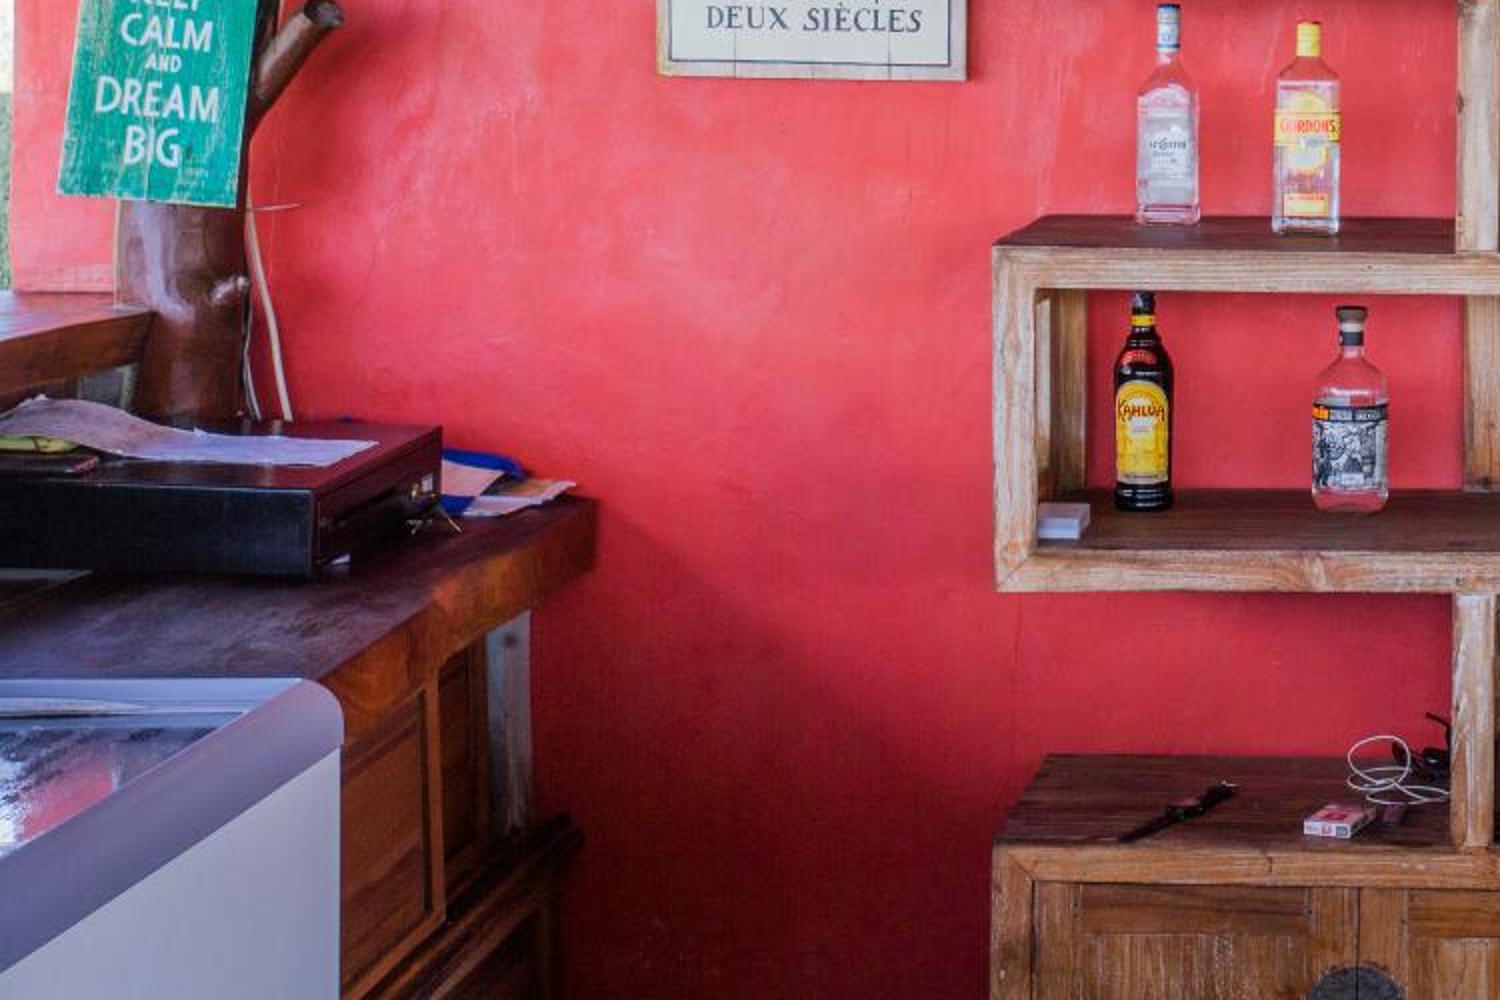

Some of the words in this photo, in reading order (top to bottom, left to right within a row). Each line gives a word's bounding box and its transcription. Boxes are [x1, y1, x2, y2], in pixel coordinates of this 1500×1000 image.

[120, 13, 213, 53] CALM
[706, 5, 789, 30] DEUX
[145, 53, 182, 73] AND
[95, 76, 220, 123] DREAM
[122, 124, 180, 168] BIG
